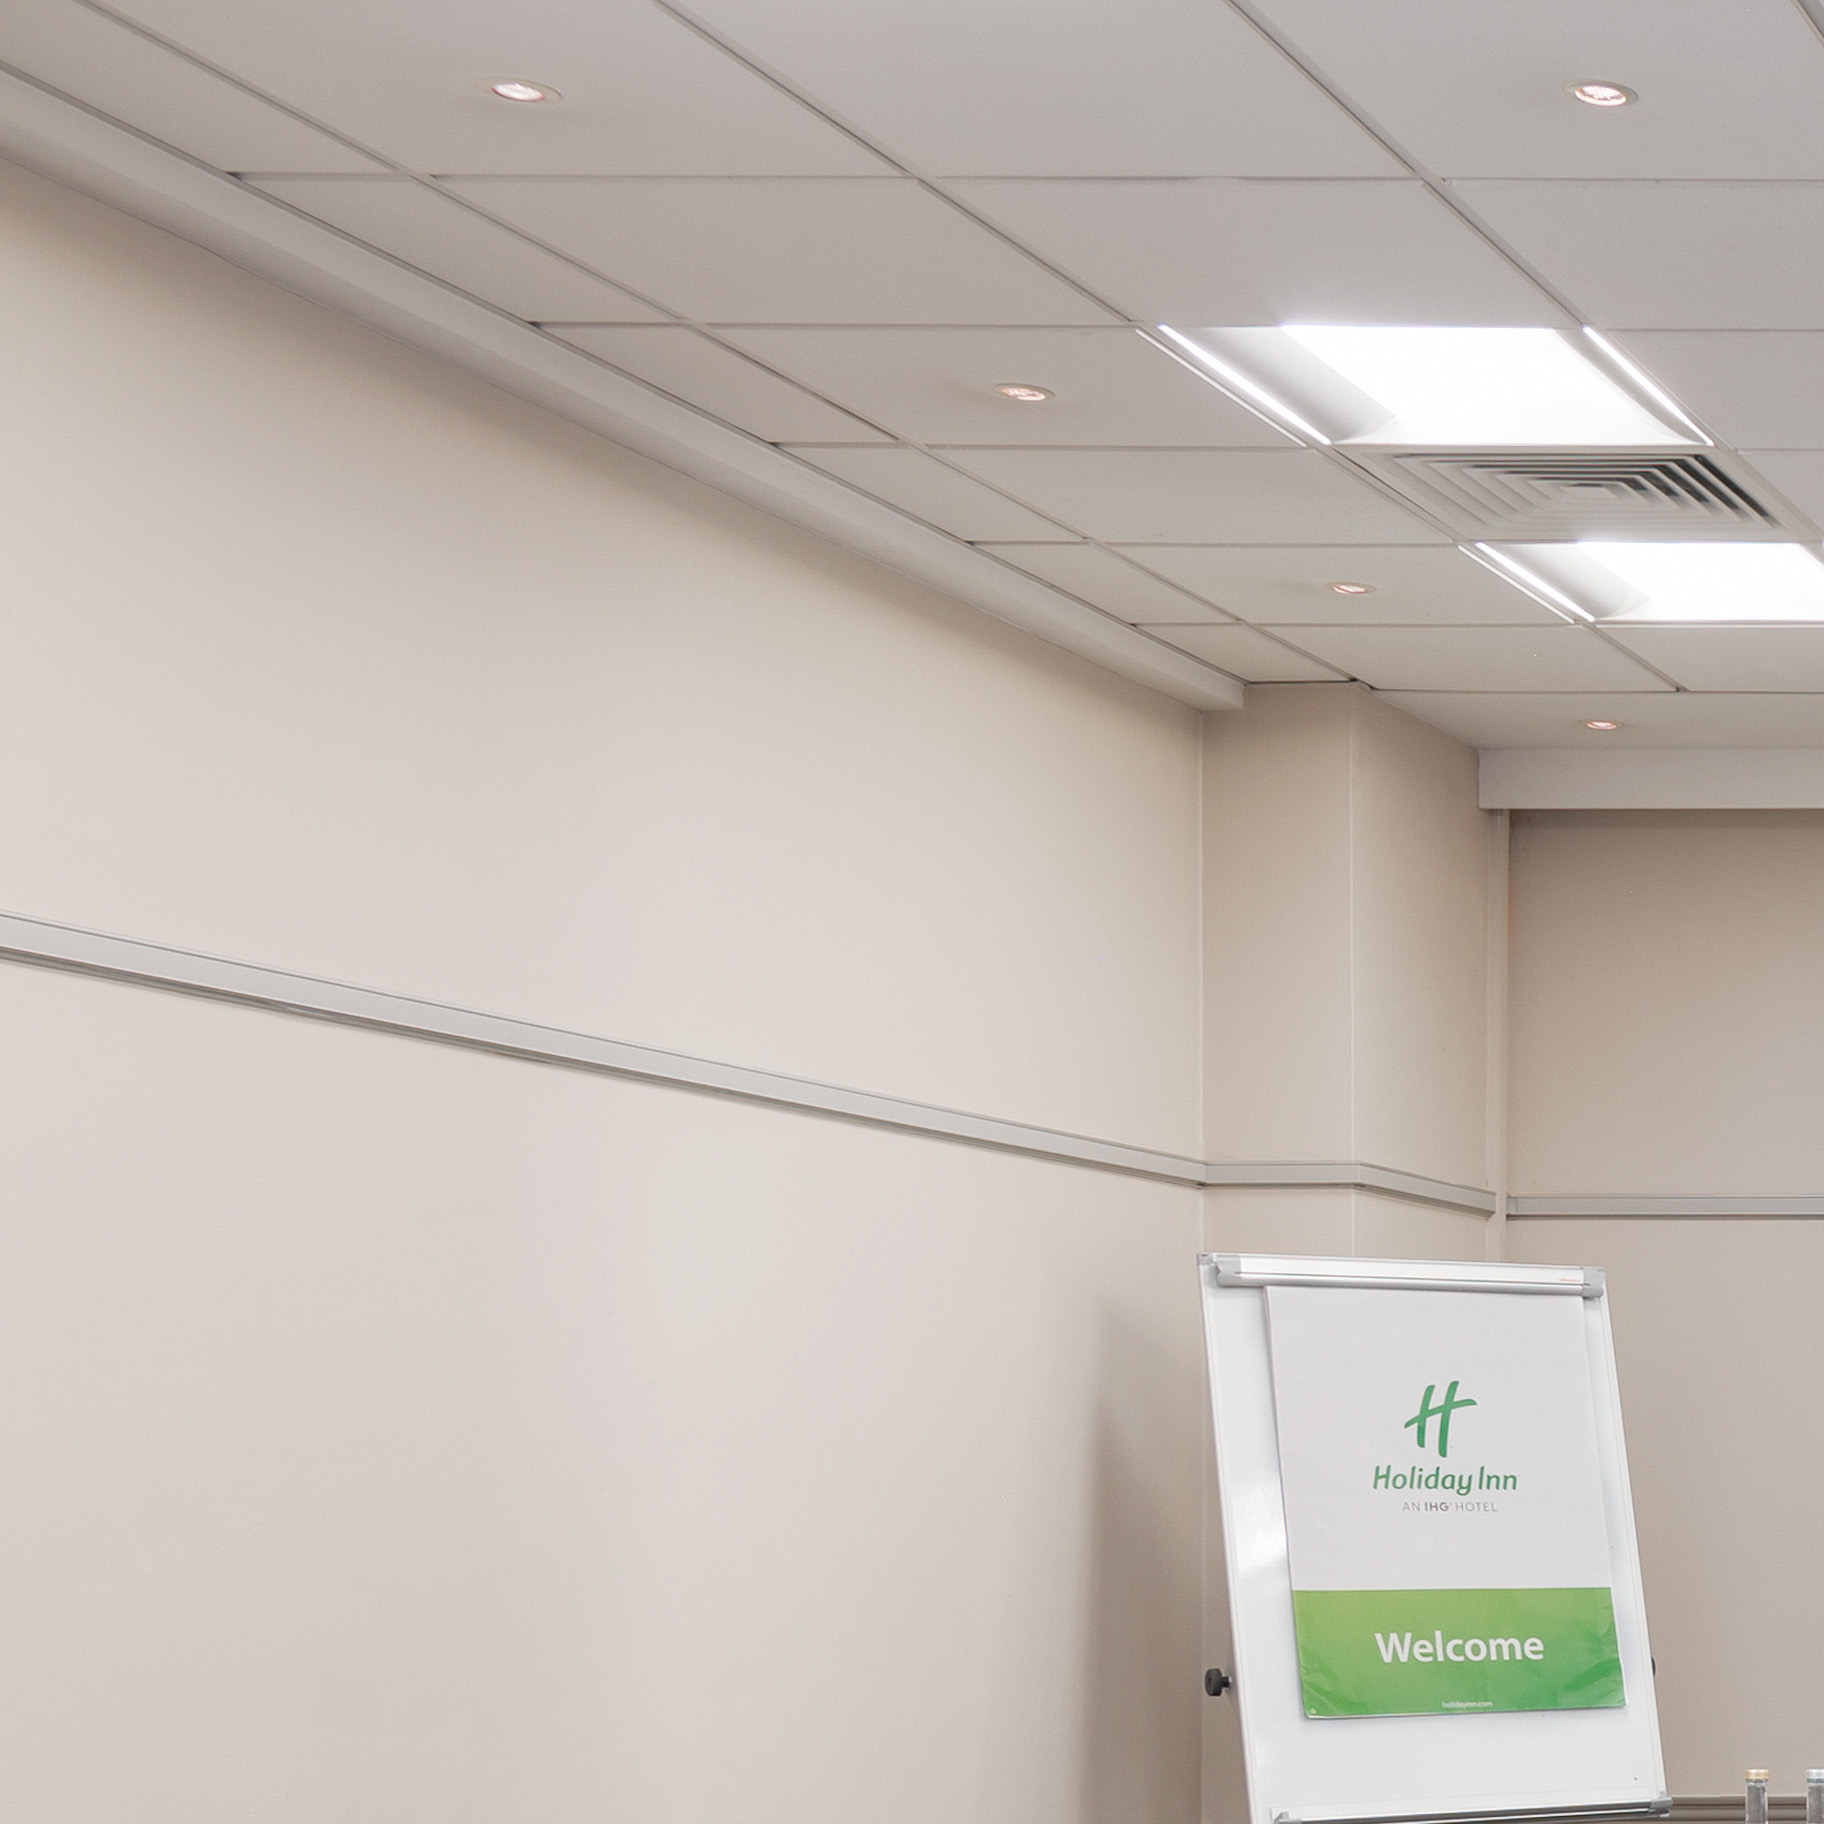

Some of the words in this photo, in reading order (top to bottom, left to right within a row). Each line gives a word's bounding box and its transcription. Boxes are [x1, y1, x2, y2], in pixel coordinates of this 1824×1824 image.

[1372, 1464, 1473, 1497] Holiday
[1477, 1465, 1518, 1491] Inn
[1401, 1501, 1421, 1512] AN
[1455, 1501, 1498, 1513] HOTEL
[1374, 1629, 1545, 1664] Welcome
